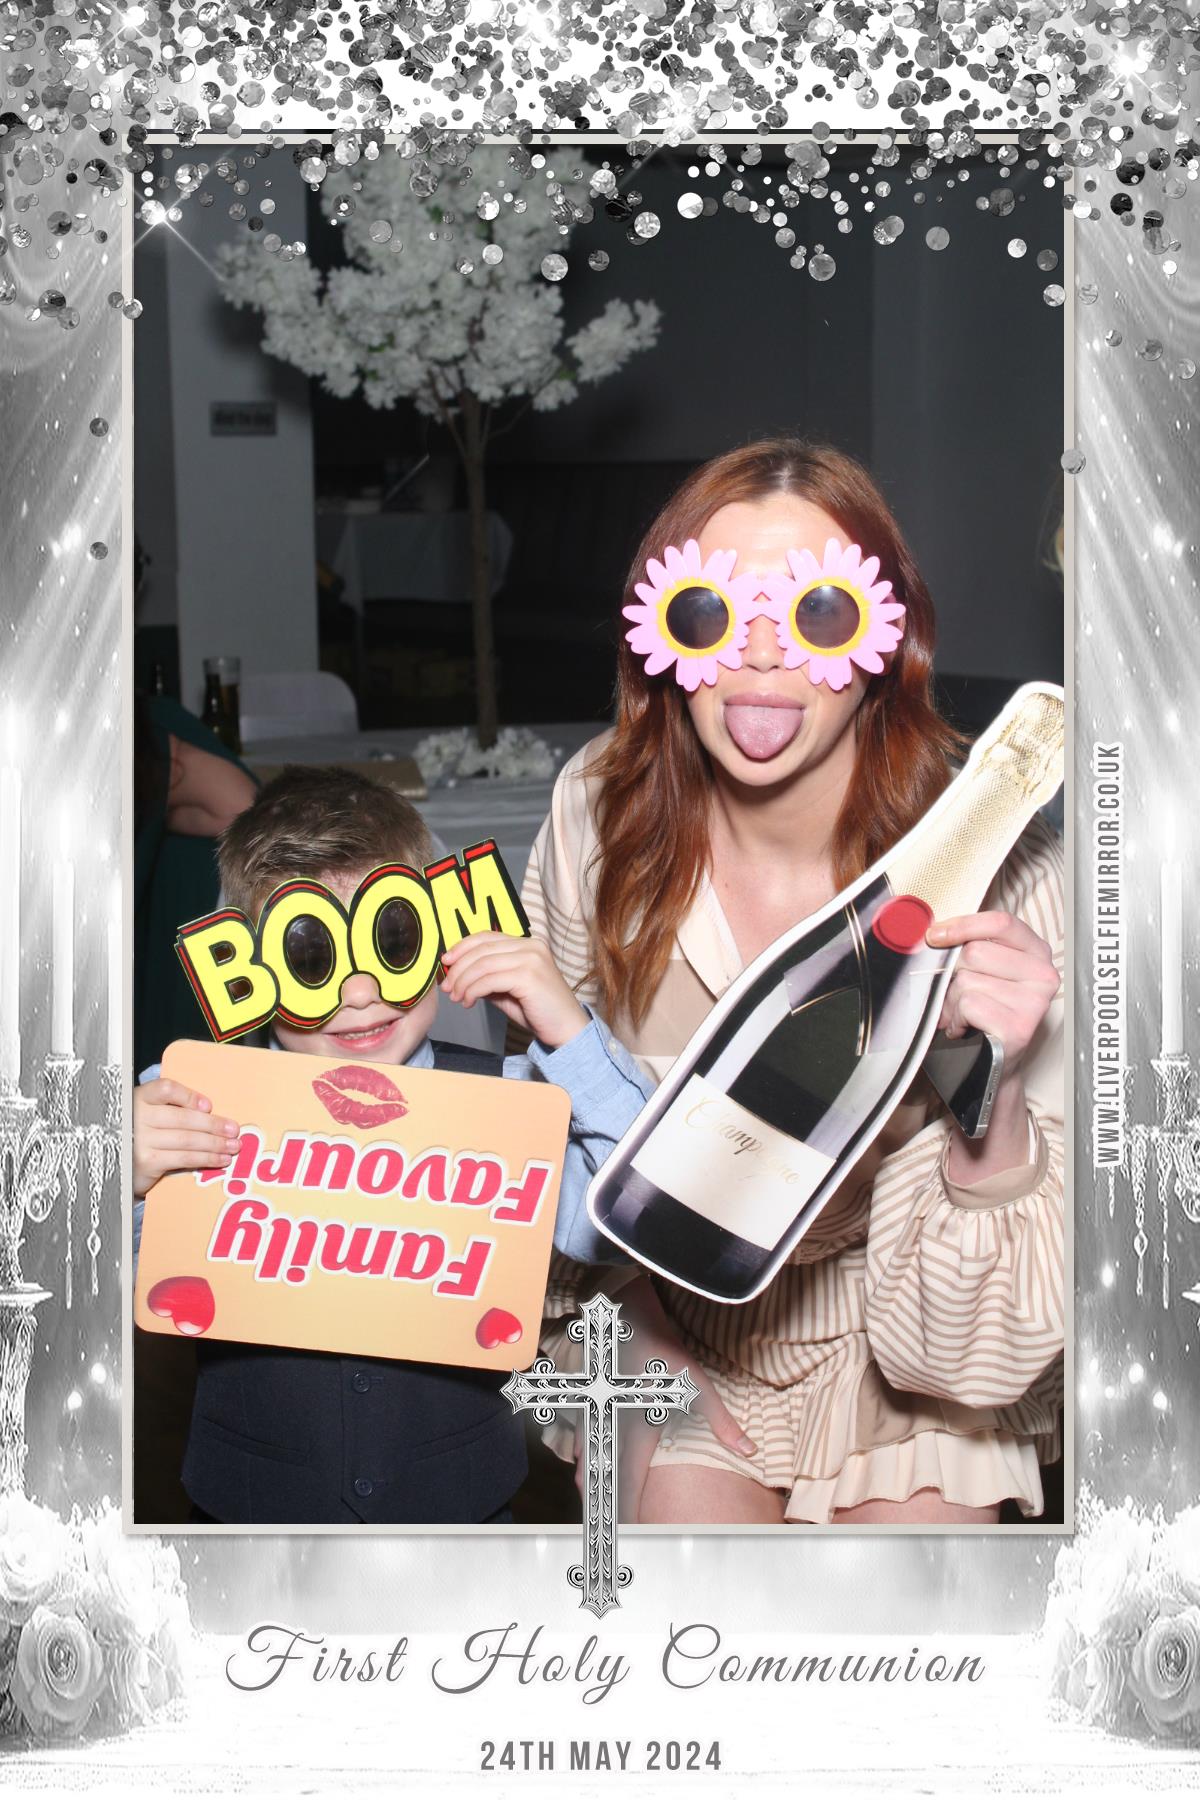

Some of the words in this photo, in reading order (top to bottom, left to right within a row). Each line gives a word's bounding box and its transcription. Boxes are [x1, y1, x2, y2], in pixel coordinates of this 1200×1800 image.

[176, 841, 530, 1040] BOOM
[197, 1128, 550, 1224] Favouri
[209, 1199, 493, 1298] Family
